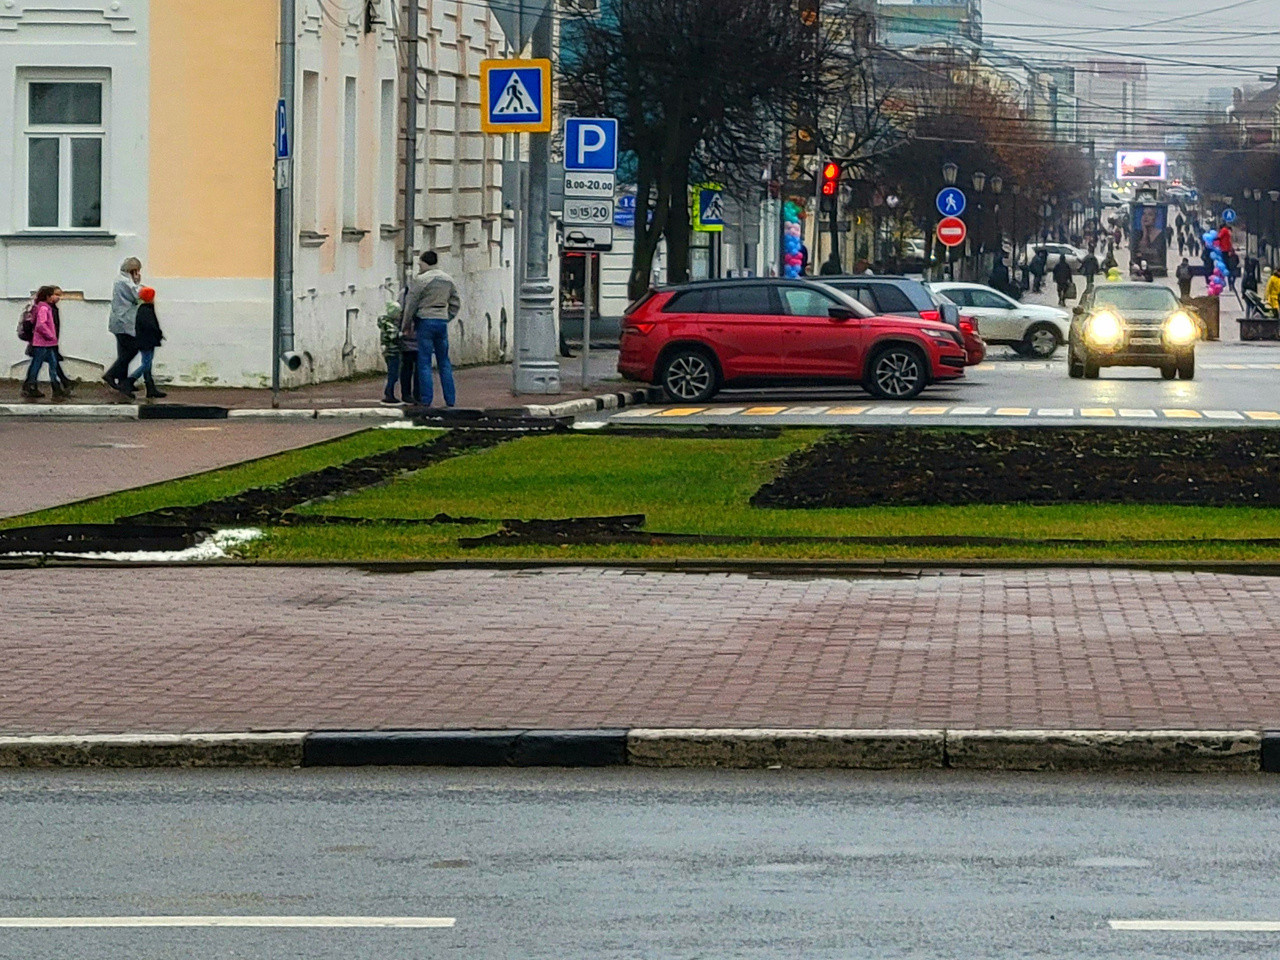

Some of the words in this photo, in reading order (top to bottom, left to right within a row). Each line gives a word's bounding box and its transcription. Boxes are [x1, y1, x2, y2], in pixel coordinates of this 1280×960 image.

[577, 124, 606, 164] P
[566, 179, 612, 190] 8.00-20.00
[569, 208, 578, 216] 10
[580, 207, 590, 217] 15
[592, 207, 607, 218] 20
